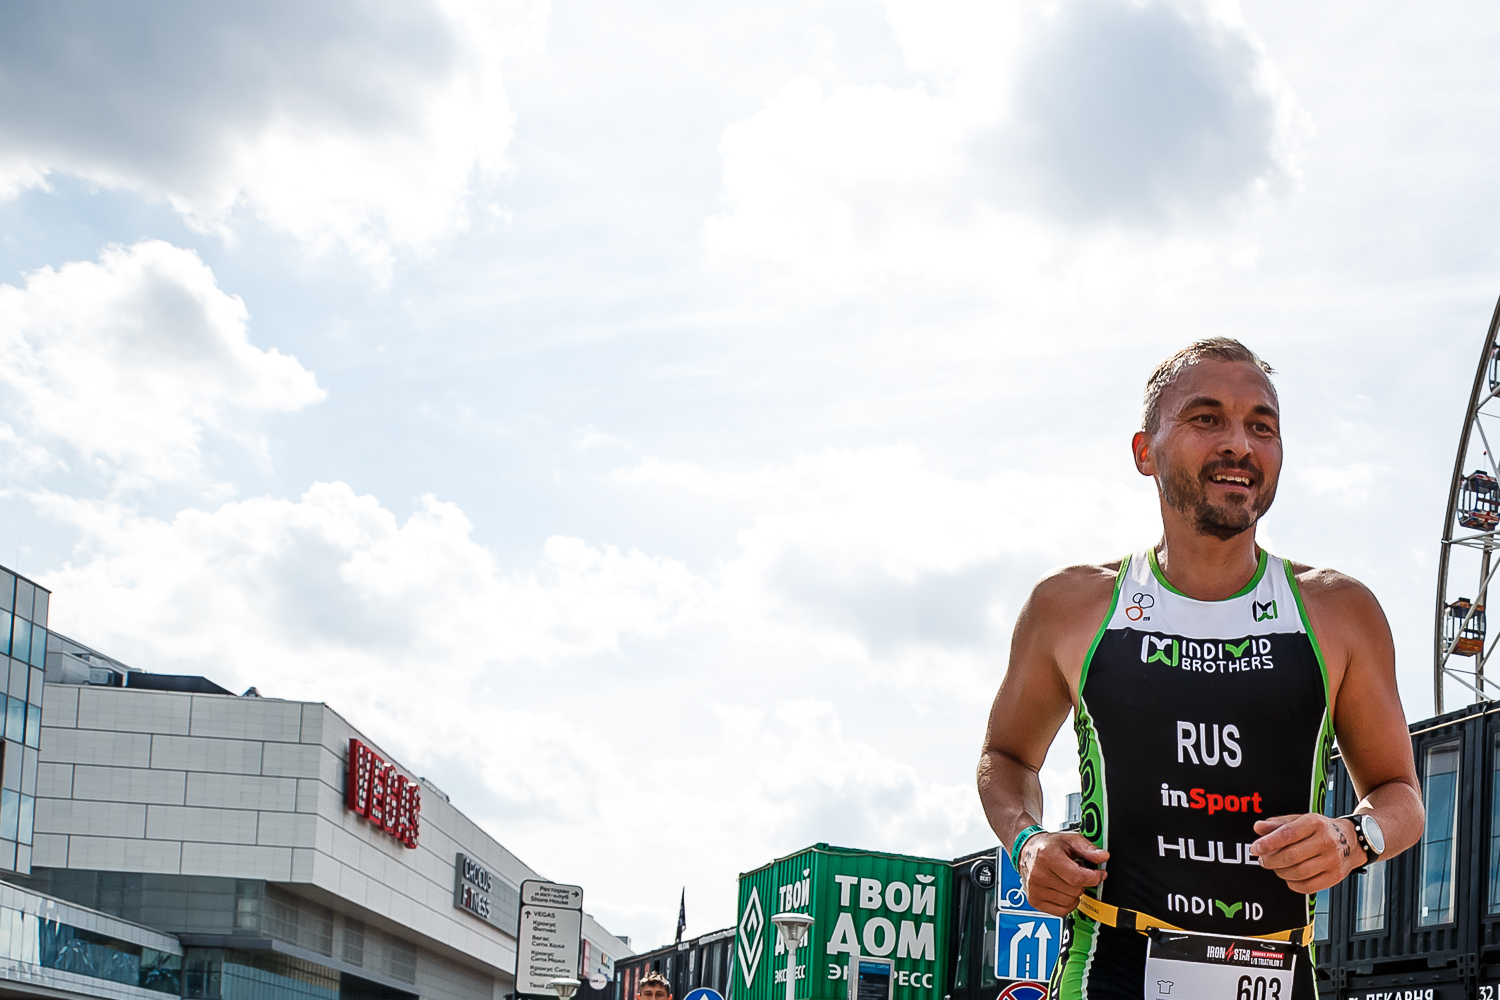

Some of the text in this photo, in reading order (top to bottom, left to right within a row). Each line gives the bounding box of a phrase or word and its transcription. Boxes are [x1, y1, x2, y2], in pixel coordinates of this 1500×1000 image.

[1181, 655, 1275, 673] BROTHERS
[1176, 721, 1243, 767] RUS
[349, 738, 421, 849] VEGAS
[1160, 783, 1263, 815] inSport
[463, 857, 492, 893] CROCUS
[779, 868, 810, 913] ТВОЙ
[461, 883, 490, 919] FITNESS
[834, 874, 936, 916] ТВОЙ
[532, 920, 556, 928] Крокус
[826, 912, 936, 961] ДОМ
[530, 950, 554, 958] Крокус
[530, 965, 553, 973] Крокус
[1206, 945, 1251, 961] IRON STAR
[774, 964, 806, 984] ЭКСЕСС
[827, 964, 933, 988] ЭЕСС
